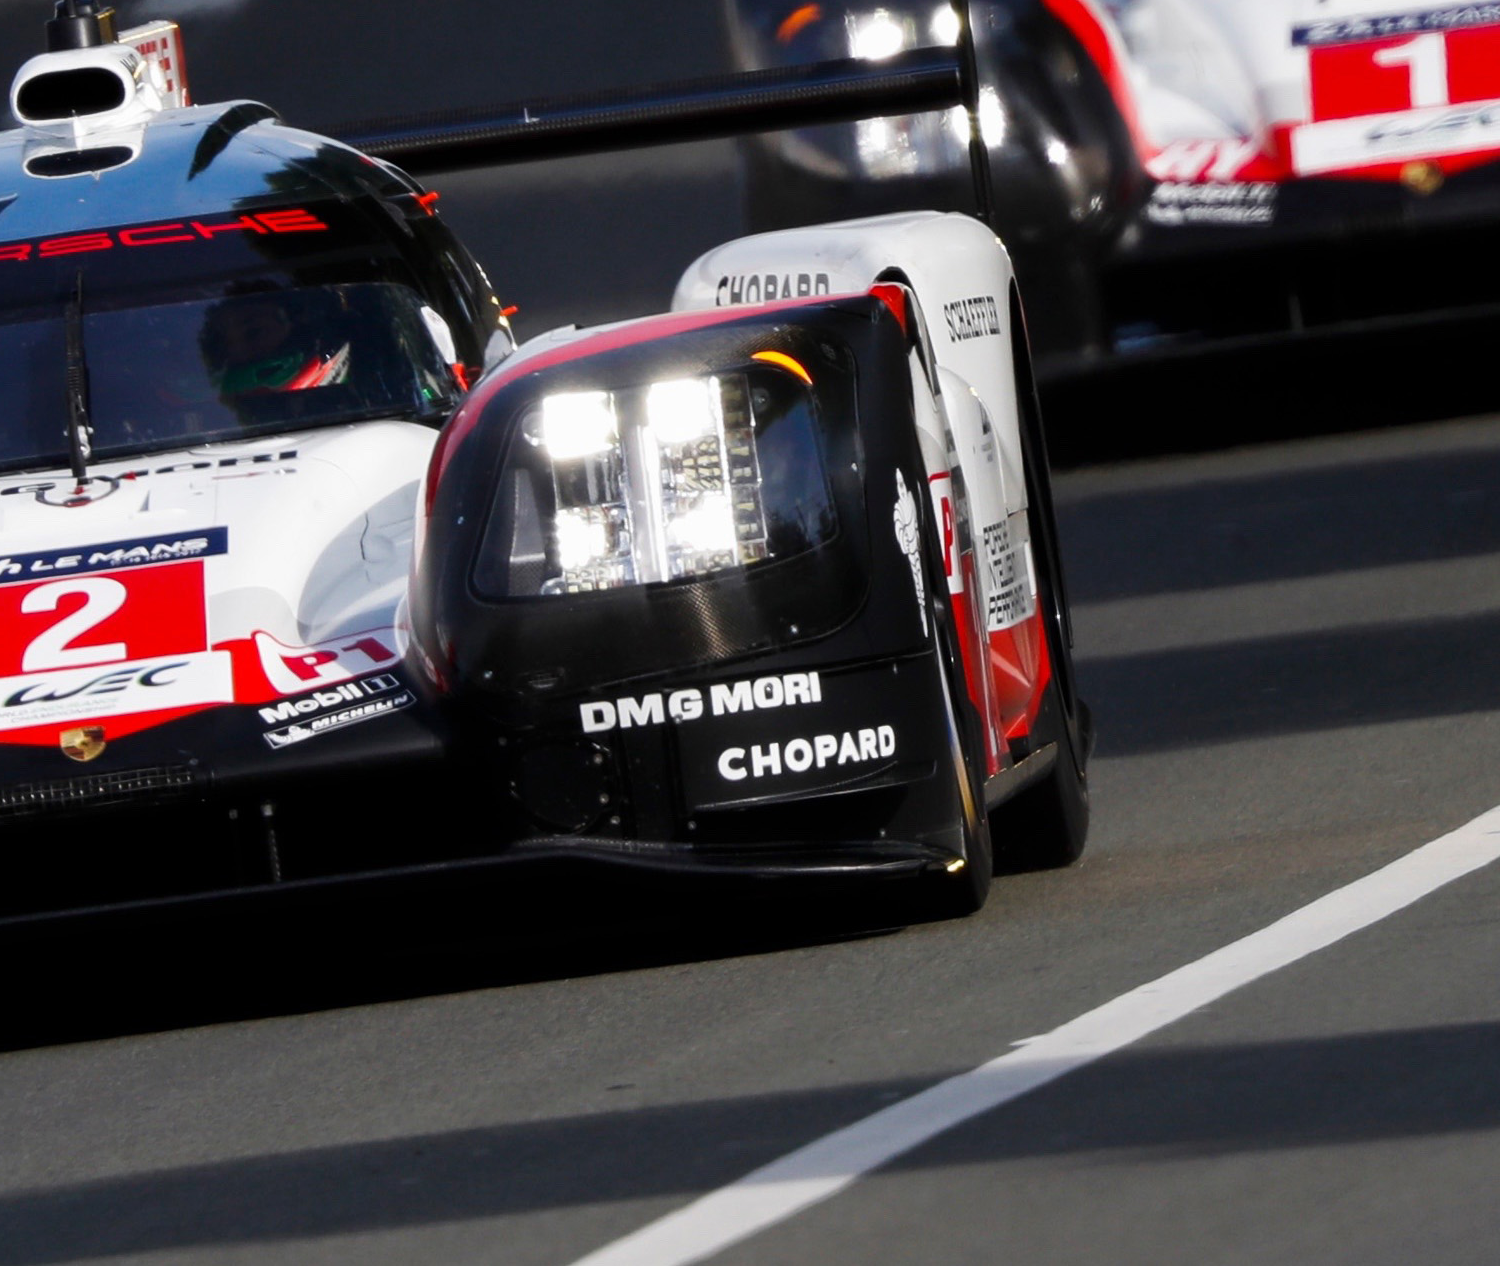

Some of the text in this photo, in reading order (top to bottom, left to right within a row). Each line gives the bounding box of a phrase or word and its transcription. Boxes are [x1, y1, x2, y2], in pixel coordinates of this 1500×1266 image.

[1372, 32, 1448, 109] 1
[30, 554, 83, 573] LE
[87, 537, 209, 565] MANS
[20, 576, 128, 673] 2
[279, 636, 396, 682] P1
[2, 661, 191, 708] WEC
[258, 683, 364, 724] Mobil
[579, 671, 823, 734] DMG MORI
[311, 694, 408, 730] MICHELIN
[716, 724, 897, 782] CHOPARD
